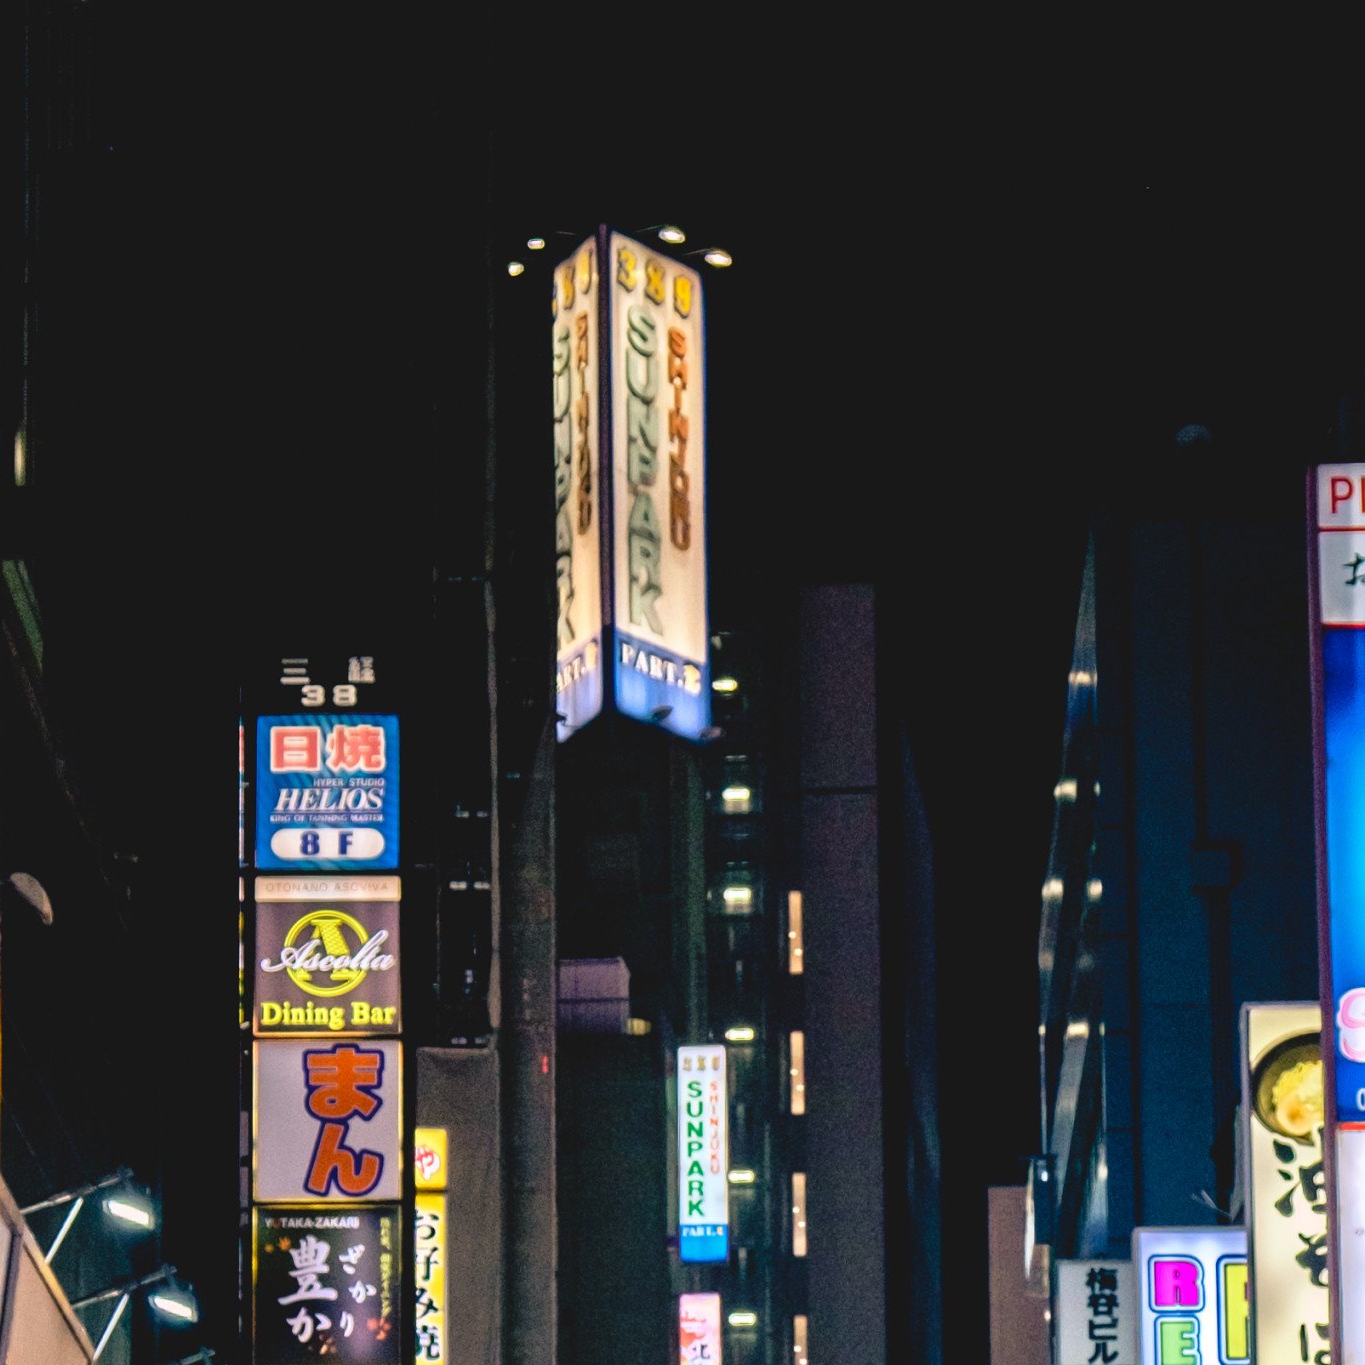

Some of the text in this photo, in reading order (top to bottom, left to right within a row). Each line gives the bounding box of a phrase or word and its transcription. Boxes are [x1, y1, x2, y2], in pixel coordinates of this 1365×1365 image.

[270, 724, 386, 774] 日焼
[274, 788, 386, 813] HELIOS
[260, 1002, 396, 1030] Dining Bar
[301, 1045, 386, 1197] まん
[687, 1080, 704, 1218] SUNPARK
